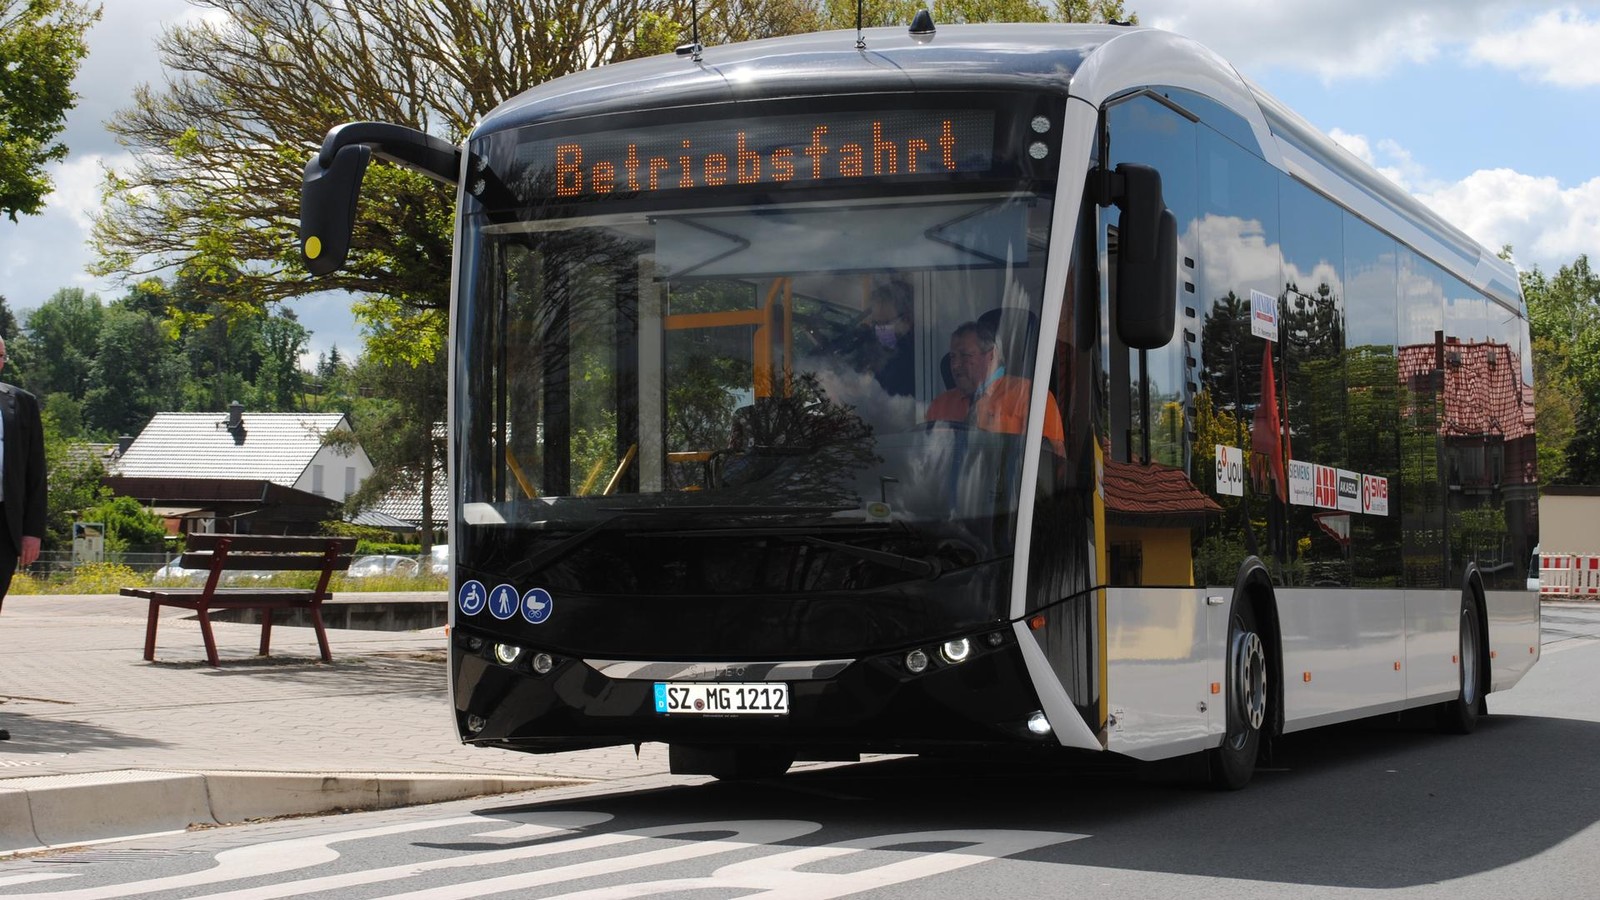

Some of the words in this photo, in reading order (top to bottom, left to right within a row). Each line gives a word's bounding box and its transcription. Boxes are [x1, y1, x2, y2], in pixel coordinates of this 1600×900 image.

[555, 120, 957, 196] Betriebsfahrt
[1290, 463, 1310, 480] SIEMENS
[1316, 467, 1336, 507] ABB
[1340, 481, 1357, 494] AKASOL
[668, 688, 691, 709] SZ
[706, 688, 731, 709] MG
[736, 688, 785, 710] 1212
